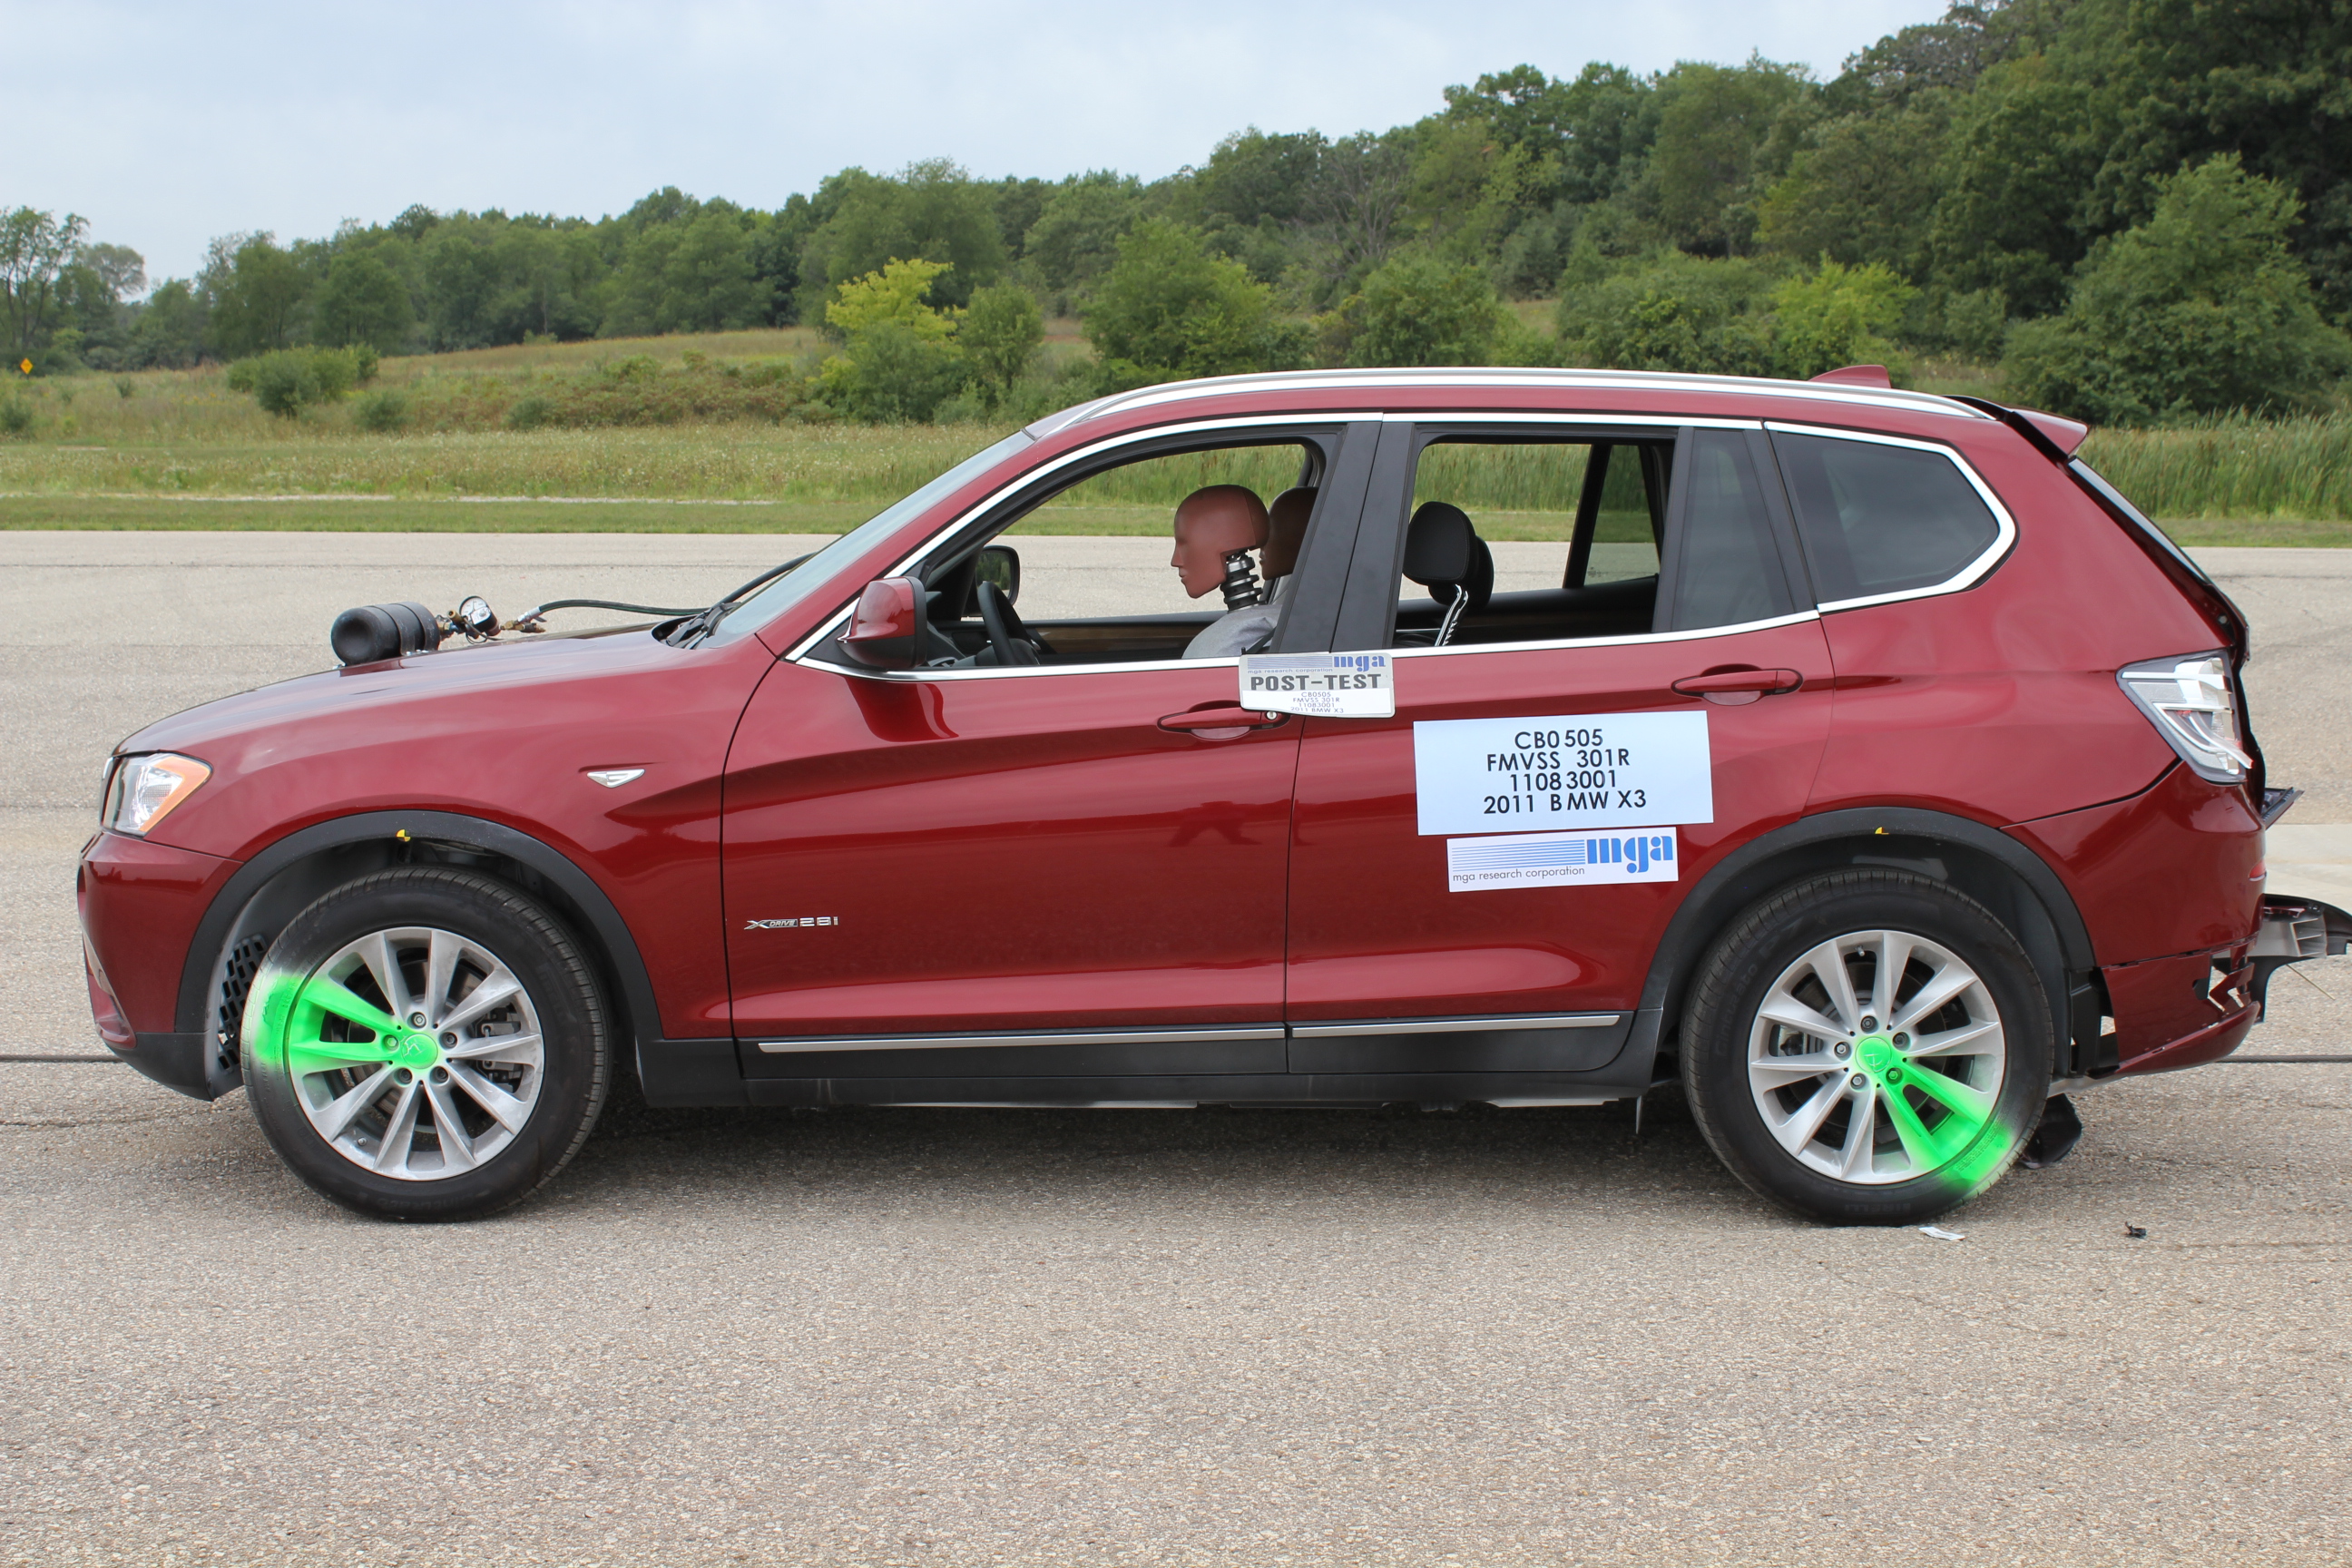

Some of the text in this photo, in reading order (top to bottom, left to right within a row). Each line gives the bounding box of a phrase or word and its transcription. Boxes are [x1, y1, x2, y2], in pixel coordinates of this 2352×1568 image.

[1334, 656, 1386, 672] mga
[1250, 673, 1381, 691] POST-TEST
[1486, 749, 1631, 771] FMVSS 301R
[1484, 789, 1647, 814] 2011 BMW X3
[1586, 836, 1673, 874] mga
[1452, 866, 1585, 883] mga research corporation
